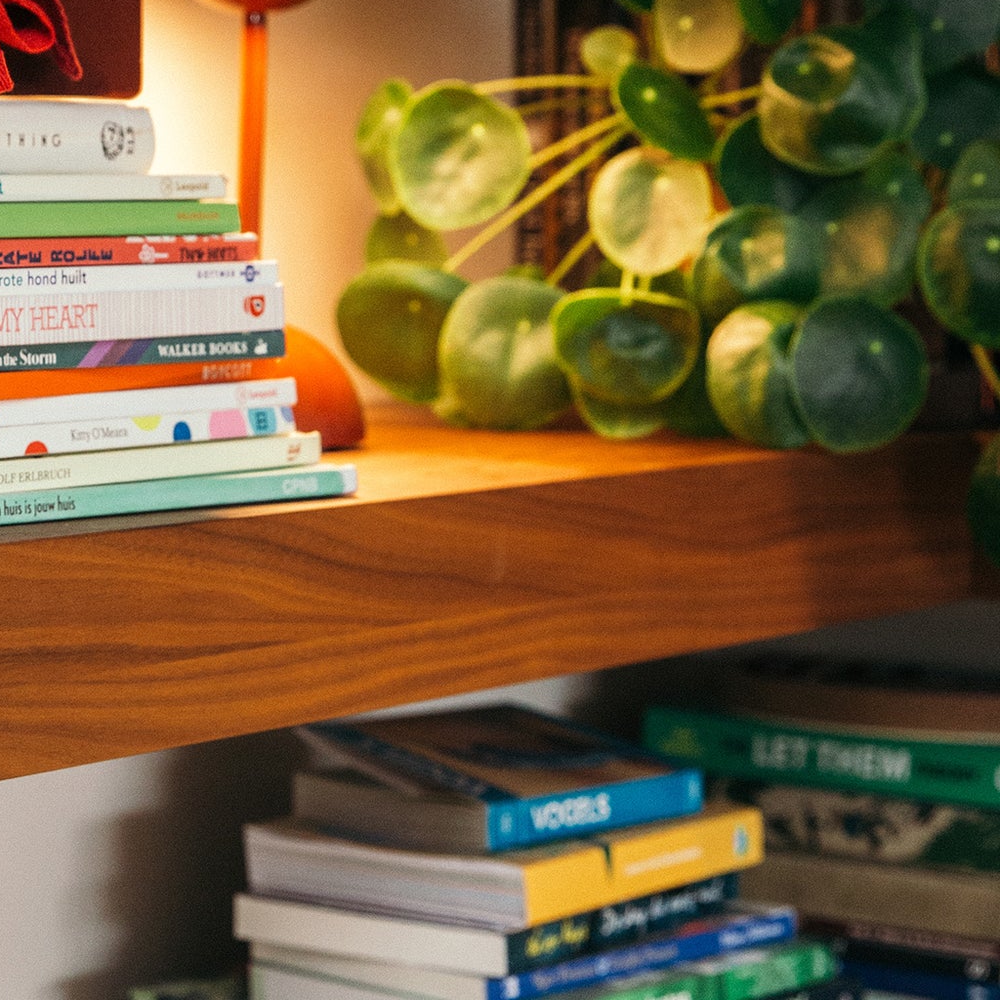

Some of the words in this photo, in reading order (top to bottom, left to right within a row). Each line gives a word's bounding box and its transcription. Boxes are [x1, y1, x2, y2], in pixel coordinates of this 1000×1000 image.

[50, 248, 113, 263] ROLFE
[27, 270, 57, 286] hond
[60, 269, 87, 285] huilt
[29, 304, 99, 332] HEART
[1, 351, 18, 366] the
[18, 349, 58, 366] Storm
[157, 342, 206, 358] WALKER
[208, 340, 249, 356] BOOKS
[18, 467, 72, 484] ERLBRUCH
[2, 500, 23, 517] huis
[24, 499, 33, 514] is
[32, 498, 56, 516] jouw
[56, 494, 76, 513] huis
